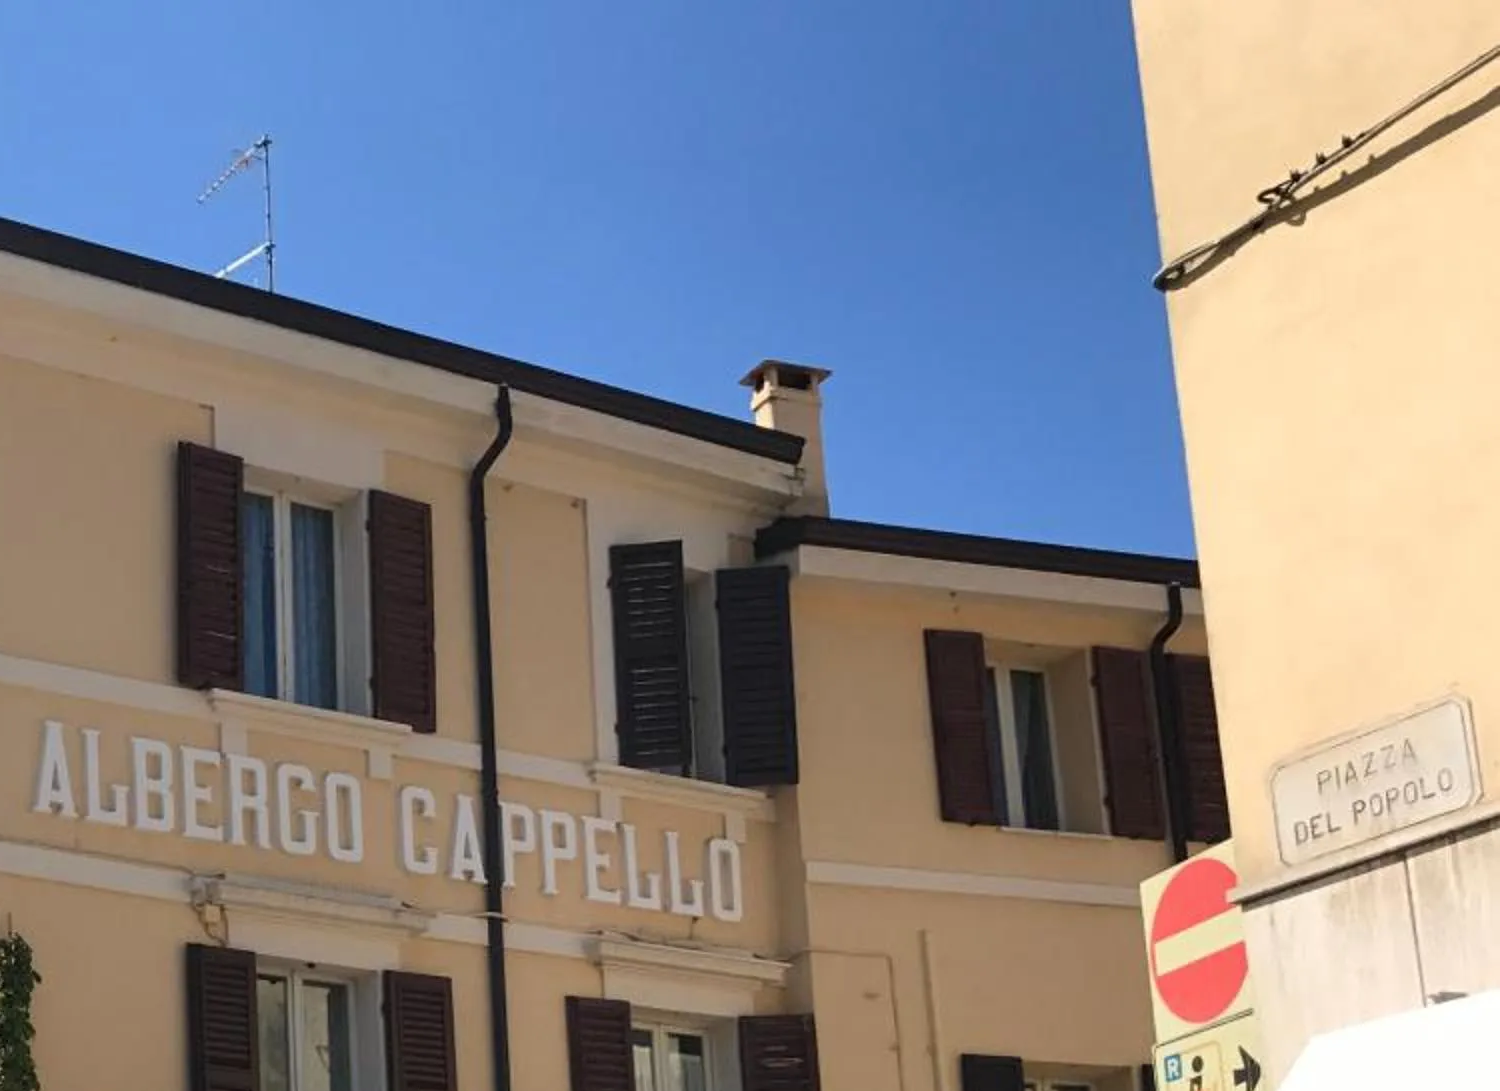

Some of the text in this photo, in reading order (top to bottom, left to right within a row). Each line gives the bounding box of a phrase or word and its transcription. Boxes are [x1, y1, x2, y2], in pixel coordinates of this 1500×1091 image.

[1293, 767, 1454, 846] DEL POPOLO
[1315, 738, 1419, 796] PIAZZA
[32, 720, 744, 922] ALBERGO CAPPELLO
